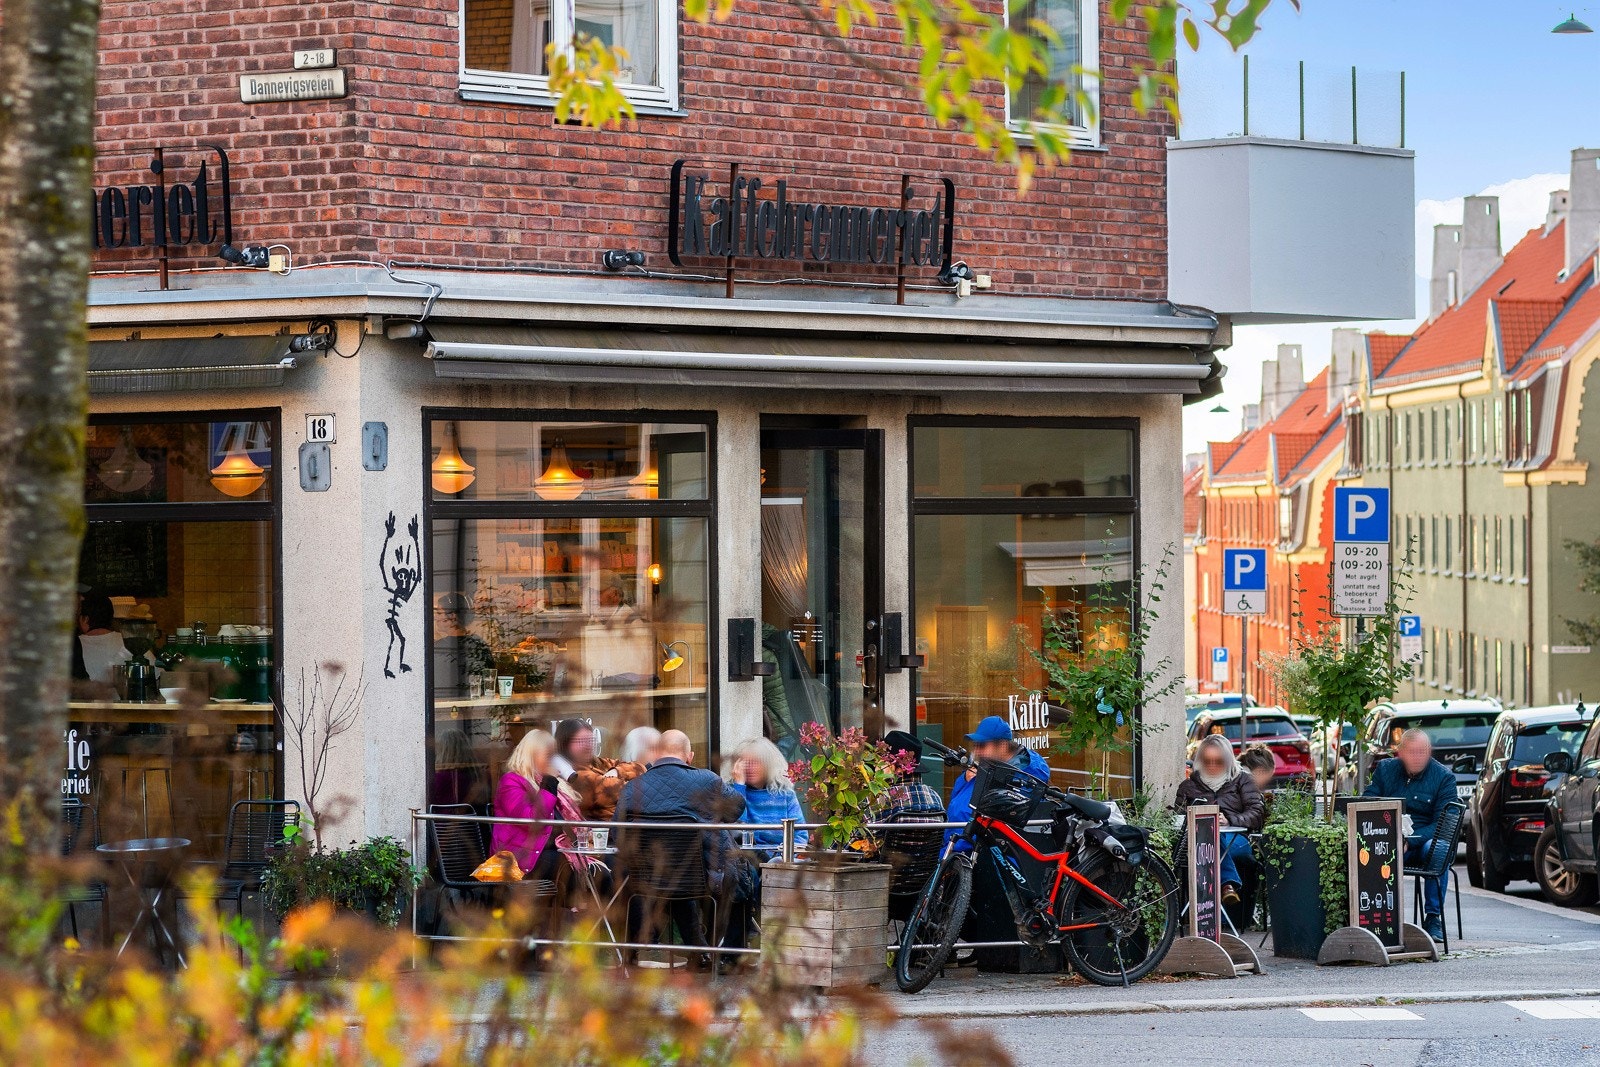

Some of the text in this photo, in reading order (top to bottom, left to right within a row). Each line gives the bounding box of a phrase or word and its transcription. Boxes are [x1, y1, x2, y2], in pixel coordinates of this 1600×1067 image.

[249, 77, 335, 97] Dannevigsveien
[311, 418, 327, 440] 18
[1348, 494, 1376, 535] P
[1234, 554, 1256, 585] P
[1404, 618, 1416, 635] P
[1216, 649, 1225, 662] P
[1007, 693, 1050, 731] Kaffe
